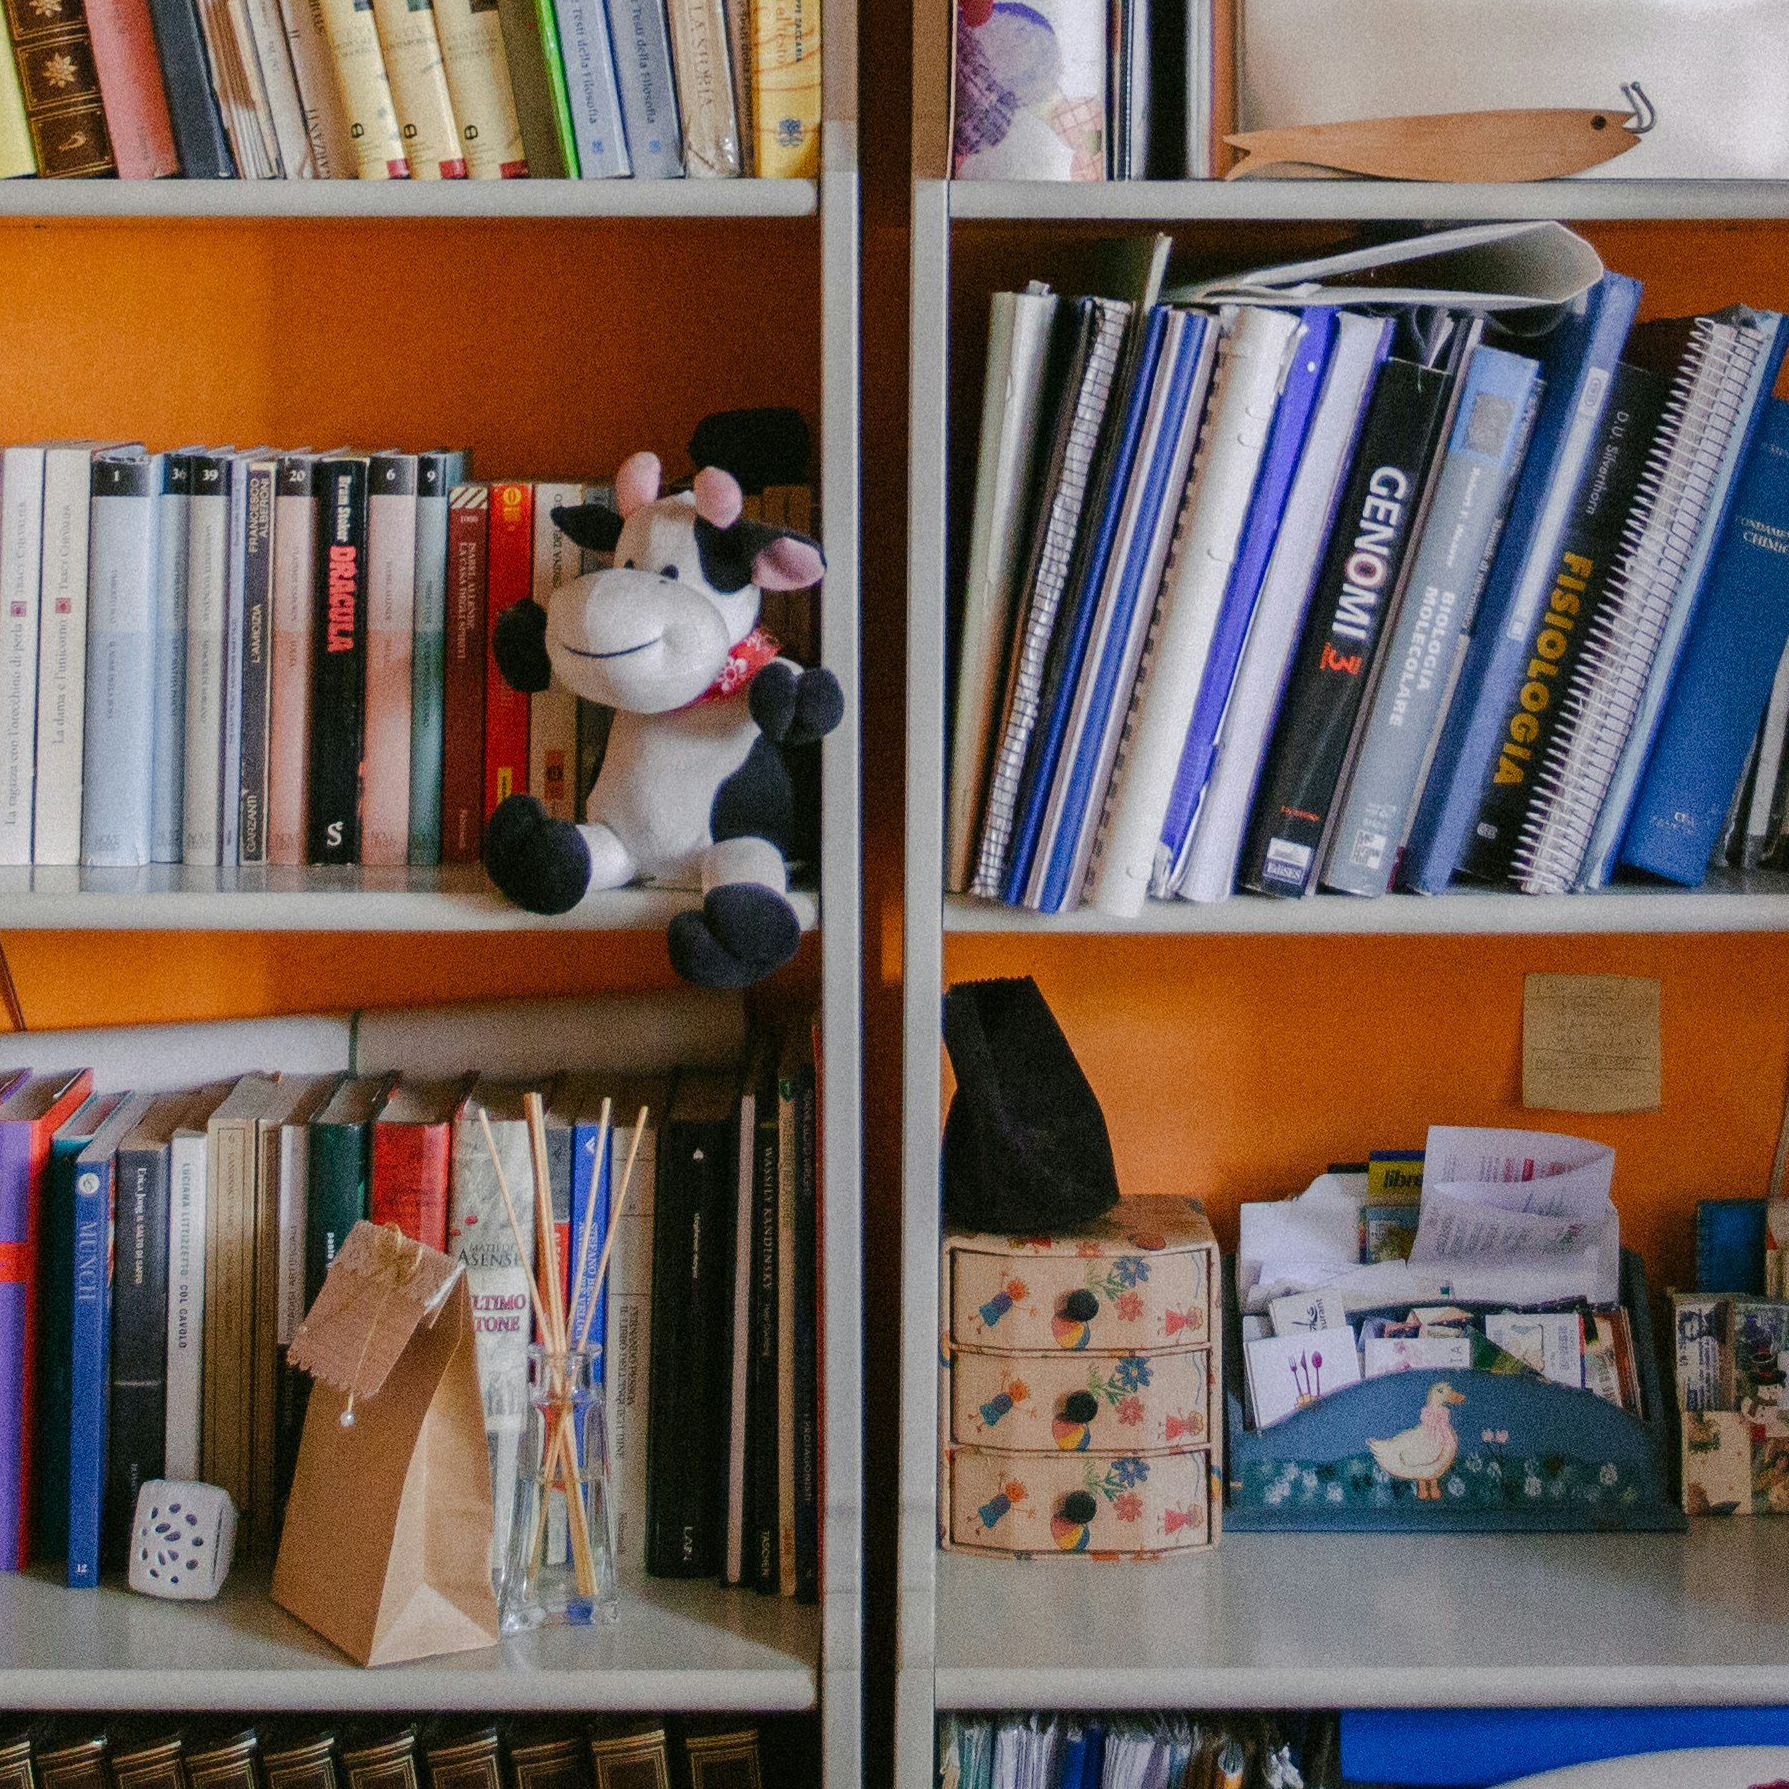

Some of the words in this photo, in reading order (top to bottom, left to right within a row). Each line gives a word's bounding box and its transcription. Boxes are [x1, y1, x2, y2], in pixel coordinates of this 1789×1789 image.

[569, 8, 586, 37] Testi
[630, 8, 646, 37] Testi
[573, 40, 592, 70] della
[634, 40, 652, 70] della
[579, 73, 599, 125] Filosofia
[637, 73, 658, 125] Filosofia
[1608, 410, 1630, 440] D.U.
[204, 468, 218, 480] 39
[289, 469, 305, 482] 20
[337, 475, 352, 504] Bram
[386, 470, 396, 481] 6
[426, 470, 435, 482] 9
[1586, 444, 1620, 516] Silverthorn
[249, 478, 260, 554] FRANCESCO
[259, 478, 269, 540] ALBERONI
[336, 506, 350, 543] Stoker
[1332, 466, 1407, 639] GENOMI
[326, 545, 355, 653] DRACULA
[10, 623, 24, 651] perla
[54, 620, 68, 680] l'unicorno
[1416, 591, 1456, 692] BIOLOGIA
[11, 653, 23, 667] di
[1318, 642, 1362, 675] 3
[1386, 586, 1438, 727] MOLECOLARE
[1494, 552, 1594, 785] FISIOLOGIA
[7, 670, 23, 736] l'orecchino
[53, 694, 65, 726] dama
[8, 739, 20, 761] con
[53, 729, 64, 745] La
[6, 765, 19, 807] ragazza
[5, 810, 17, 825] La
[181, 1162, 191, 1208] LUCIANA
[78, 1221, 100, 1300] MUNCH
[178, 1284, 188, 1305] COL
[177, 1309, 188, 1349] CAVOLO
[76, 1564, 87, 1573] 12
